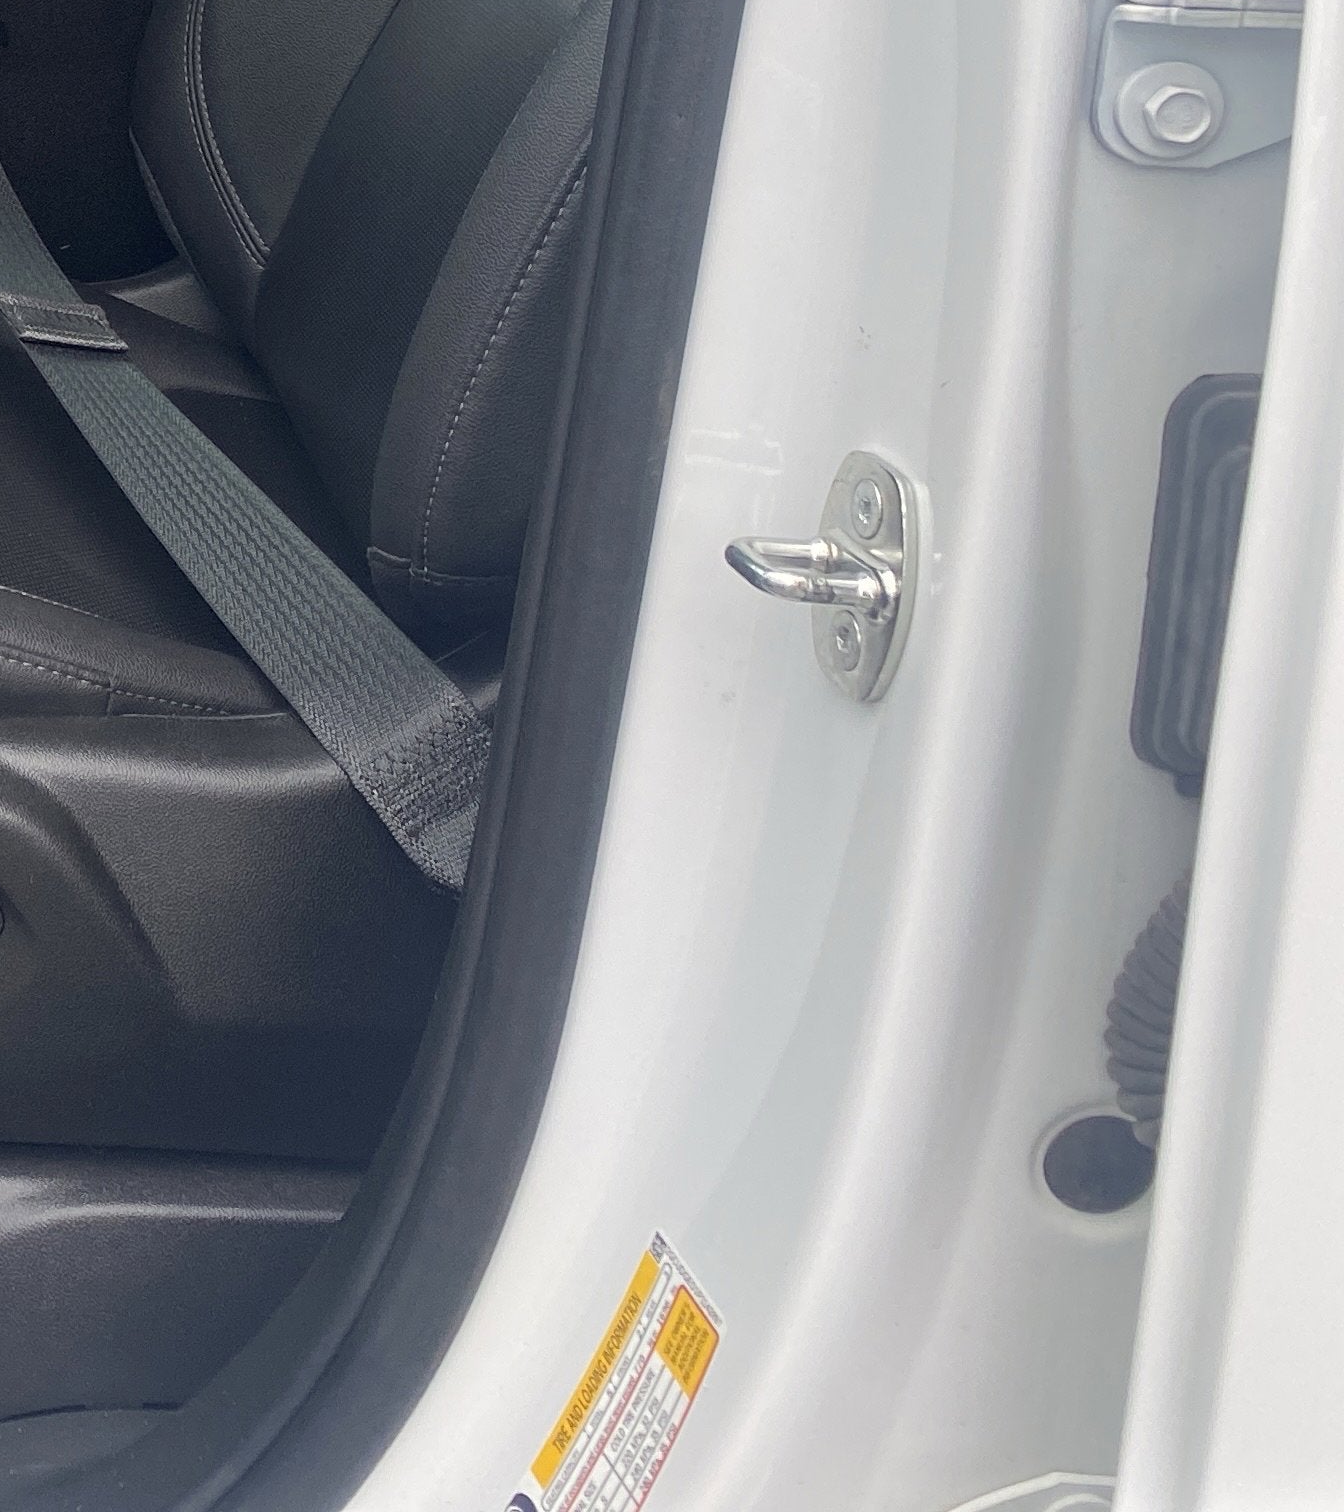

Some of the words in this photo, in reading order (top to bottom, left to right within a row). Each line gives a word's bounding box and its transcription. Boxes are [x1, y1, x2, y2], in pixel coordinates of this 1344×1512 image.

[552, 1424, 570, 1454] TIRE
[567, 1404, 584, 1432] AND
[580, 1359, 608, 1410] LOADING
[605, 1291, 642, 1366] INFORMATION
